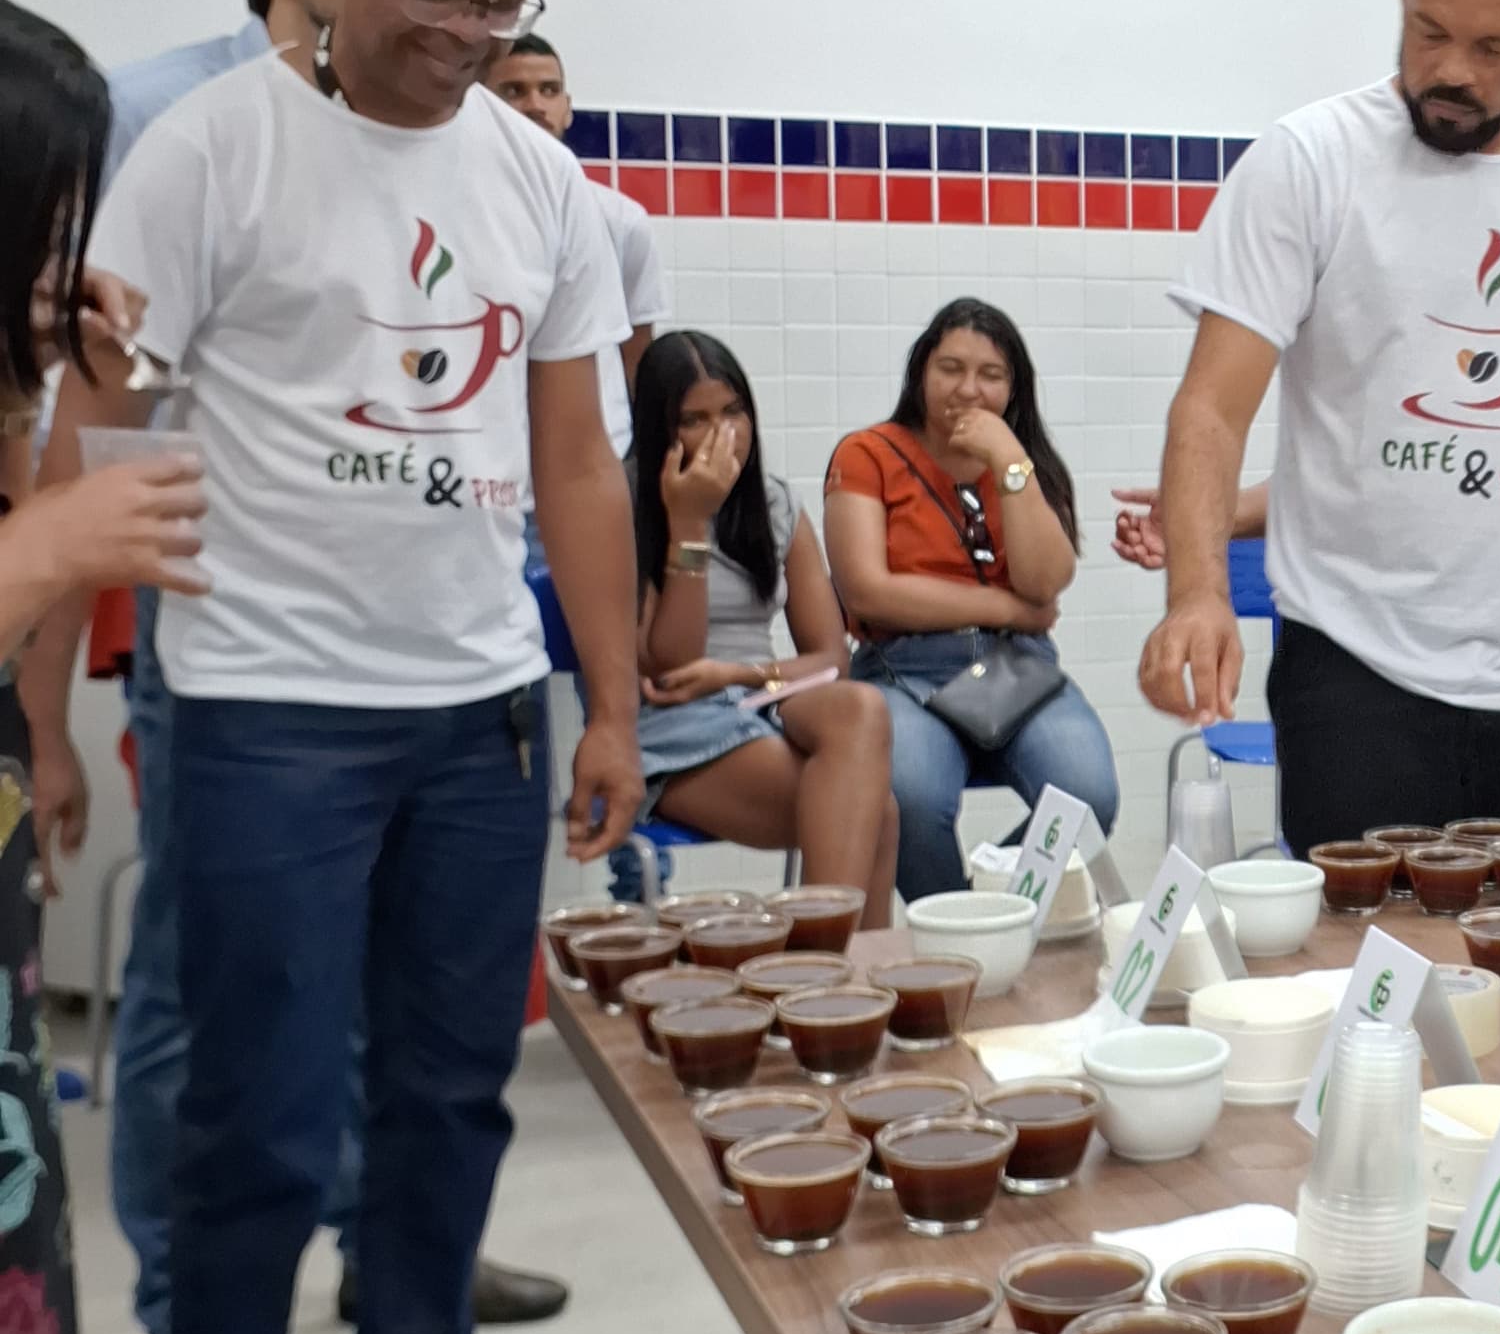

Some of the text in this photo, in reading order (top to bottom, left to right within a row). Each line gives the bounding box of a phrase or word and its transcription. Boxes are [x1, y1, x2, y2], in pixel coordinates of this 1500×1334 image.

[327, 443, 418, 484] CAFÉ
[424, 458, 462, 508] &
[1382, 434, 1458, 474] CAFÉ
[1459, 450, 1495, 499] &
